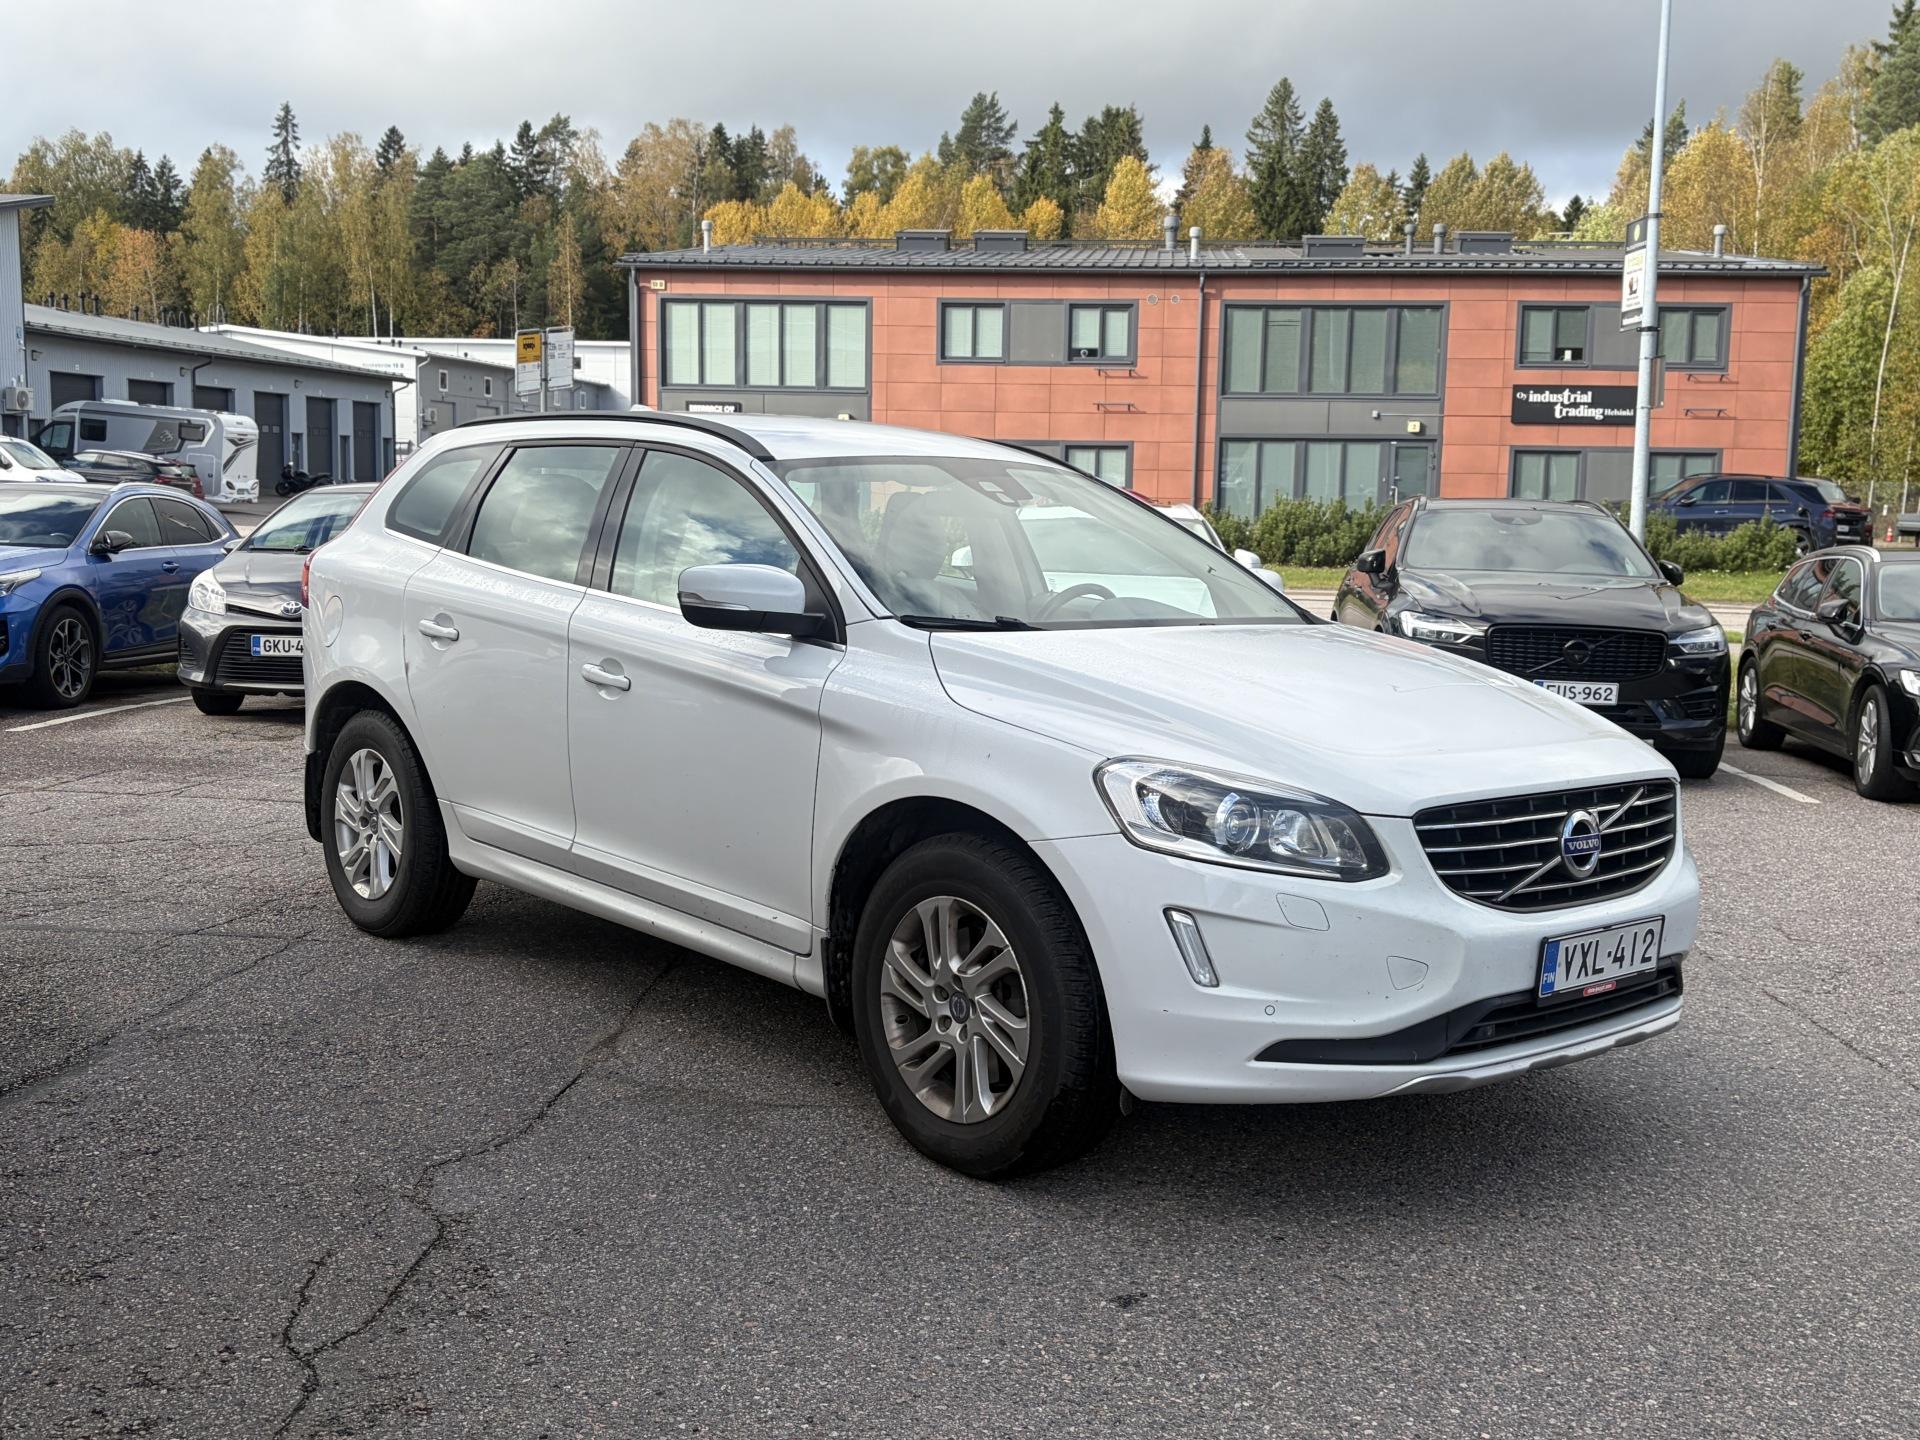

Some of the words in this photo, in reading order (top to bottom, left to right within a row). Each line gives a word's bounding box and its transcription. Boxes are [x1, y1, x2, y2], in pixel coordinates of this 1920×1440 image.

[1516, 391, 1527, 401] Oy
[1528, 388, 1593, 405] industrial
[1553, 402, 1605, 420] trading
[1604, 407, 1635, 417] Helsinki
[1567, 838, 1600, 851] VOLVO
[1565, 928, 1656, 982] VXL-412
[1542, 971, 1556, 985] FIN
